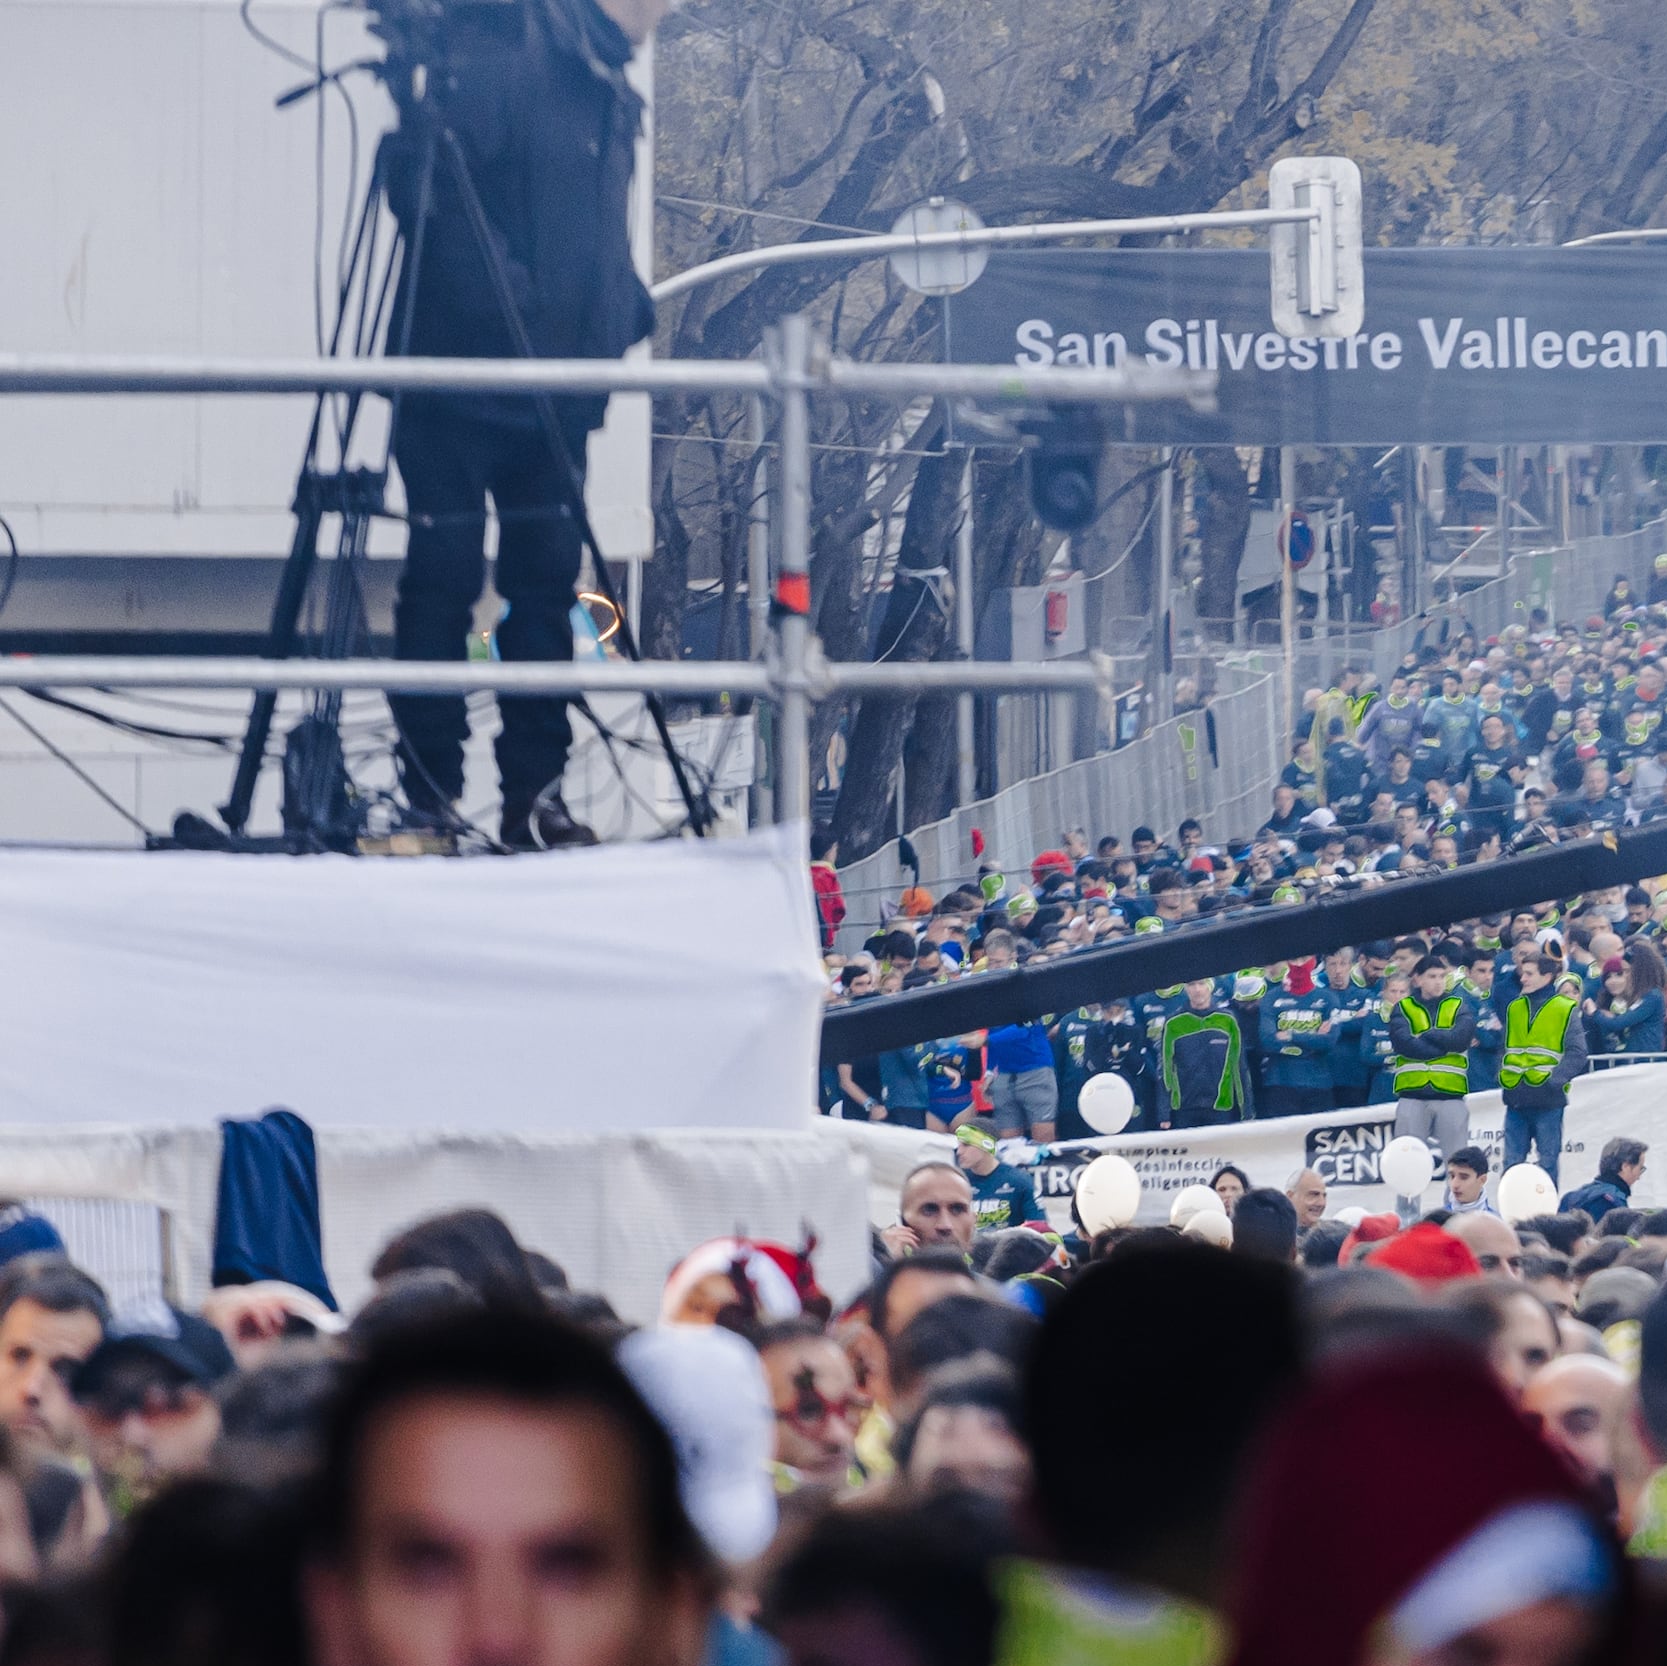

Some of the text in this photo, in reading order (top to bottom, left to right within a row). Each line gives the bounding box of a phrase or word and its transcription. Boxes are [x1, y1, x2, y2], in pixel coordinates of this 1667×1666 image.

[1014, 318, 1129, 370] San
[1144, 317, 1402, 372] Silvestre
[1314, 1123, 1393, 1155] SANI
